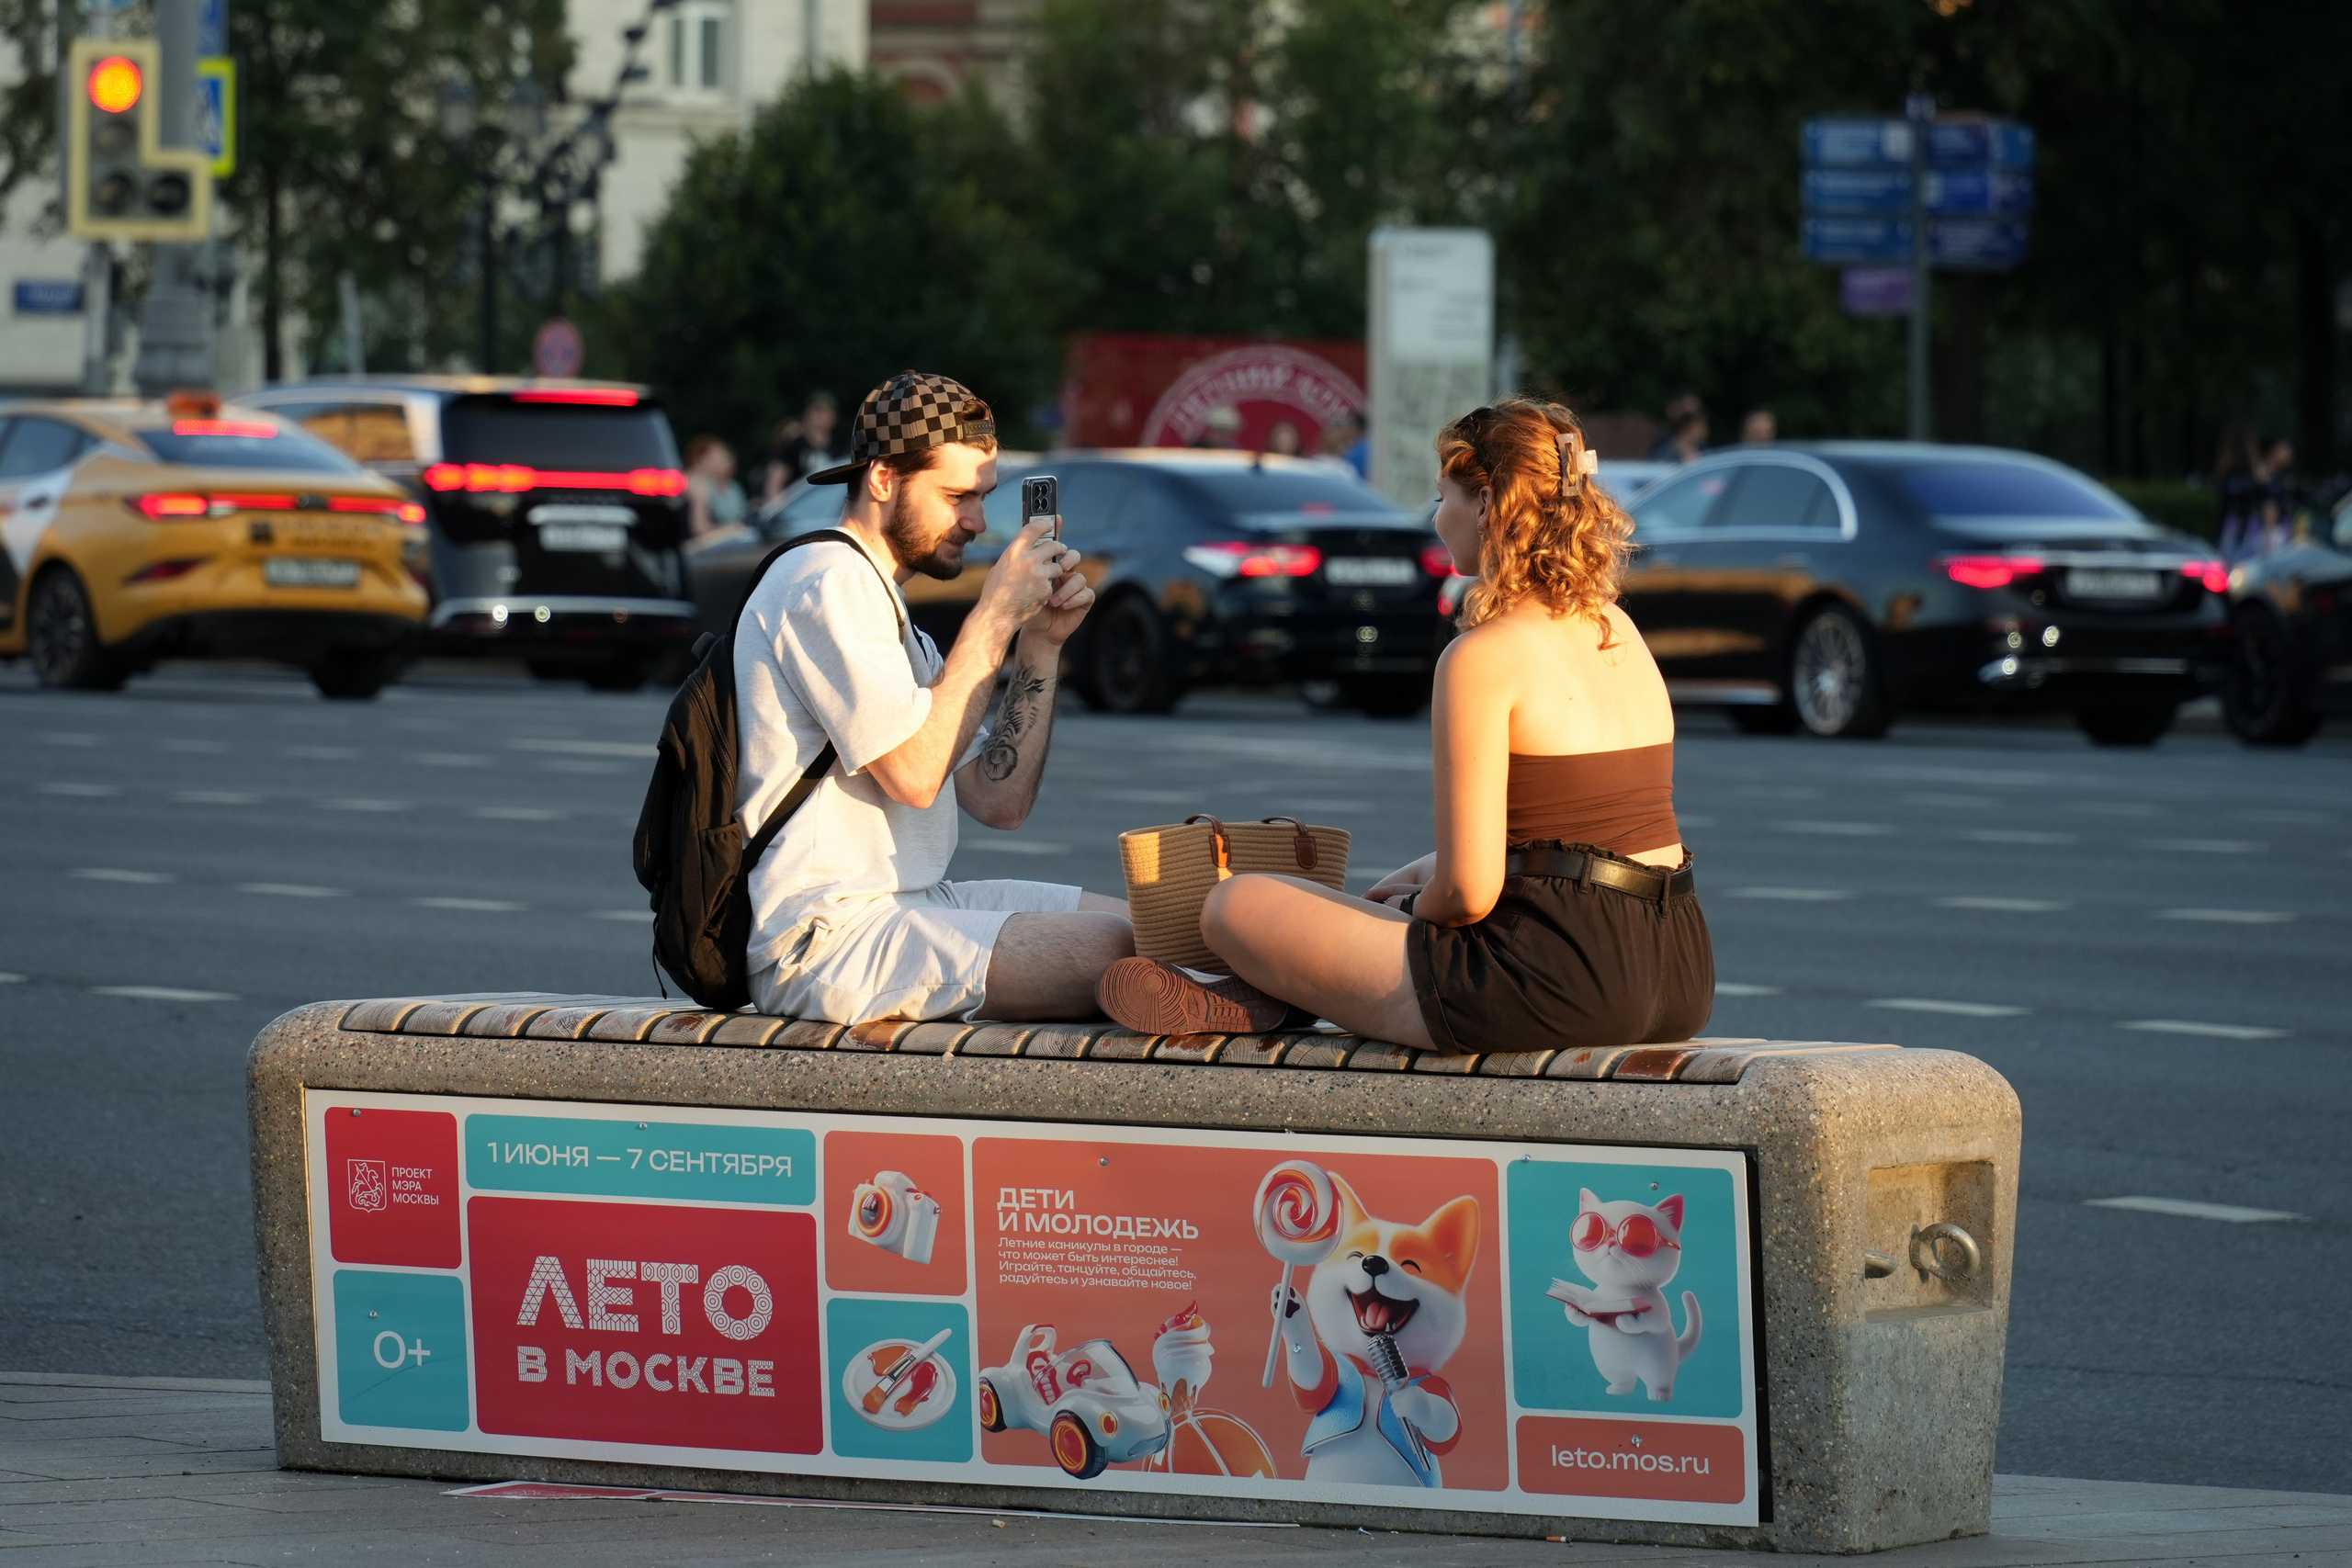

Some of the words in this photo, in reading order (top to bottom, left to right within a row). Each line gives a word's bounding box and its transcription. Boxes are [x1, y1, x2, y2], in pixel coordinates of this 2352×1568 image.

[487, 1142, 498, 1163] 1
[504, 1142, 589, 1168] ИЮНЯ
[627, 1148, 643, 1169] 7
[649, 1149, 792, 1178] СЕНТЯБРЯ
[391, 1167, 433, 1179] ПРОЕКТ
[392, 1179, 423, 1191] МЭРА
[392, 1193, 439, 1205] МОСКВЫ
[997, 1187, 1075, 1212] ДЕТИ
[998, 1211, 1018, 1232] И
[1025, 1213, 1199, 1240] МОЛОДЕЖЬ
[998, 1236, 1046, 1248] Летние
[1048, 1240, 1111, 1253] каникулы
[1114, 1244, 1121, 1252] в
[1124, 1244, 1168, 1255] городе
[998, 1250, 1020, 1259] что
[1023, 1251, 1065, 1261] может
[1068, 1251, 1099, 1263] быть
[1101, 1255, 1179, 1266] интереснее!
[999, 1260, 1056, 1274] Играйте,
[1057, 1263, 1120, 1277] танцуйте,
[1122, 1266, 1196, 1280] общайтесь,
[1000, 1272, 1069, 1285] радуйтесь
[1080, 1277, 1148, 1288] узнавайте
[1151, 1280, 1193, 1291] новое!
[516, 1256, 774, 1341] ЛЕТО
[373, 1330, 431, 1369] 0+
[516, 1346, 548, 1382] В
[565, 1348, 775, 1397] МОСКВЕ
[1552, 1444, 1710, 1474] leto.mos.ru
